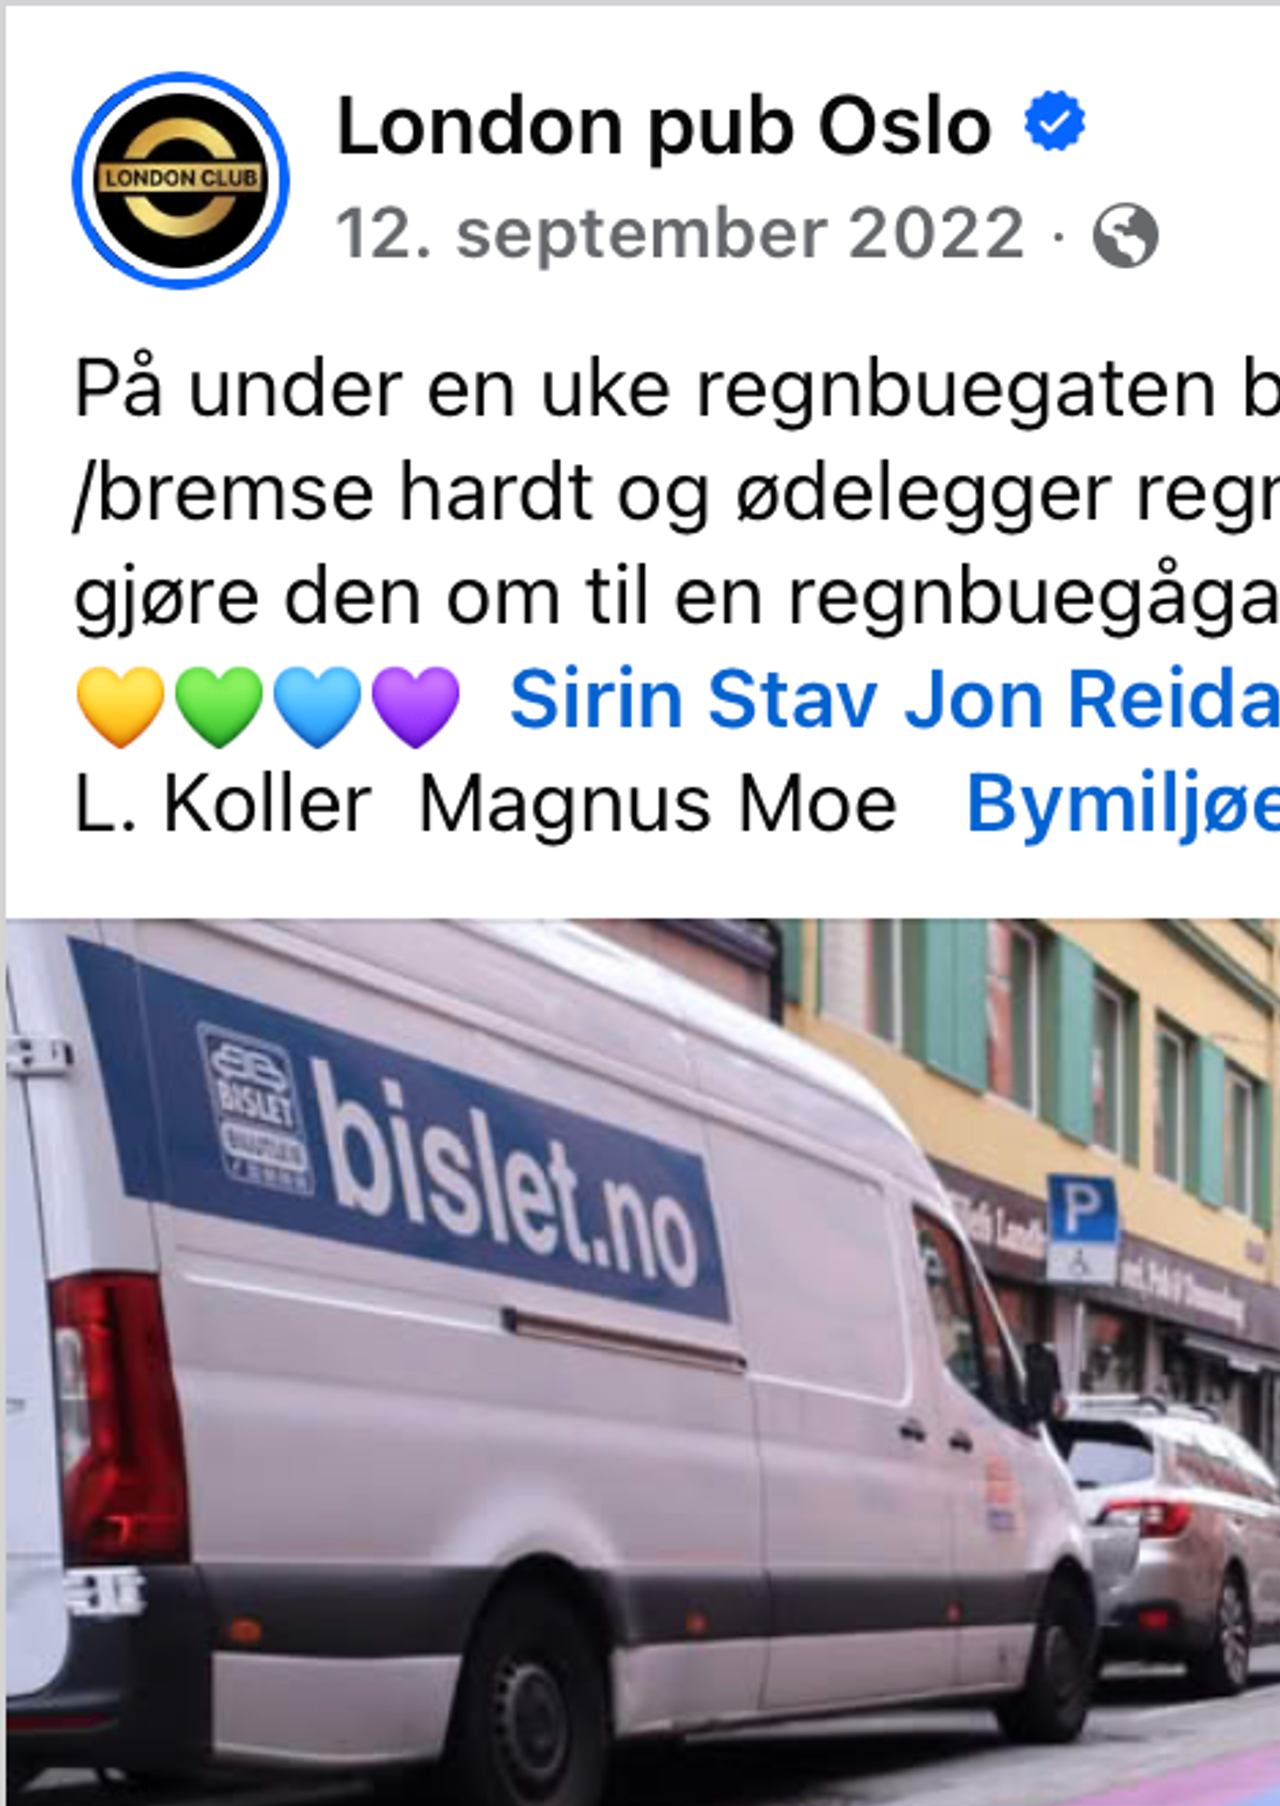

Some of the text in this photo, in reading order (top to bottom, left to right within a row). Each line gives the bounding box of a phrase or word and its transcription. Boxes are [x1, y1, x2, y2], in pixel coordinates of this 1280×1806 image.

[339, 91, 992, 170] London pub Oslo
[105, 168, 258, 187] LONDON CLUB
[337, 204, 1024, 272] 12. september 2022
[77, 346, 162, 418] På
[190, 354, 404, 418] under
[428, 370, 514, 418] en
[543, 354, 671, 418] uke
[699, 354, 1215, 433] regnbuegaten
[70, 458, 374, 536] /bremse
[401, 458, 594, 522] hardt
[617, 474, 709, 537] og
[736, 458, 1113, 537] ødelegger
[74, 561, 259, 641] gjøre
[284, 561, 420, 626] den
[447, 578, 559, 626] om
[584, 561, 647, 625] til
[675, 578, 761, 626] en
[510, 663, 682, 731] Sirin
[709, 666, 879, 730] Stav
[903, 668, 1043, 730] Jon
[77, 772, 136, 832] L.
[166, 769, 373, 833] Koller
[421, 772, 712, 848] Magnus
[741, 772, 897, 833] Moe
[217, 1080, 294, 1128] BISLET
[310, 1056, 699, 1289] bislet.no
[1064, 1182, 1101, 1234] P
